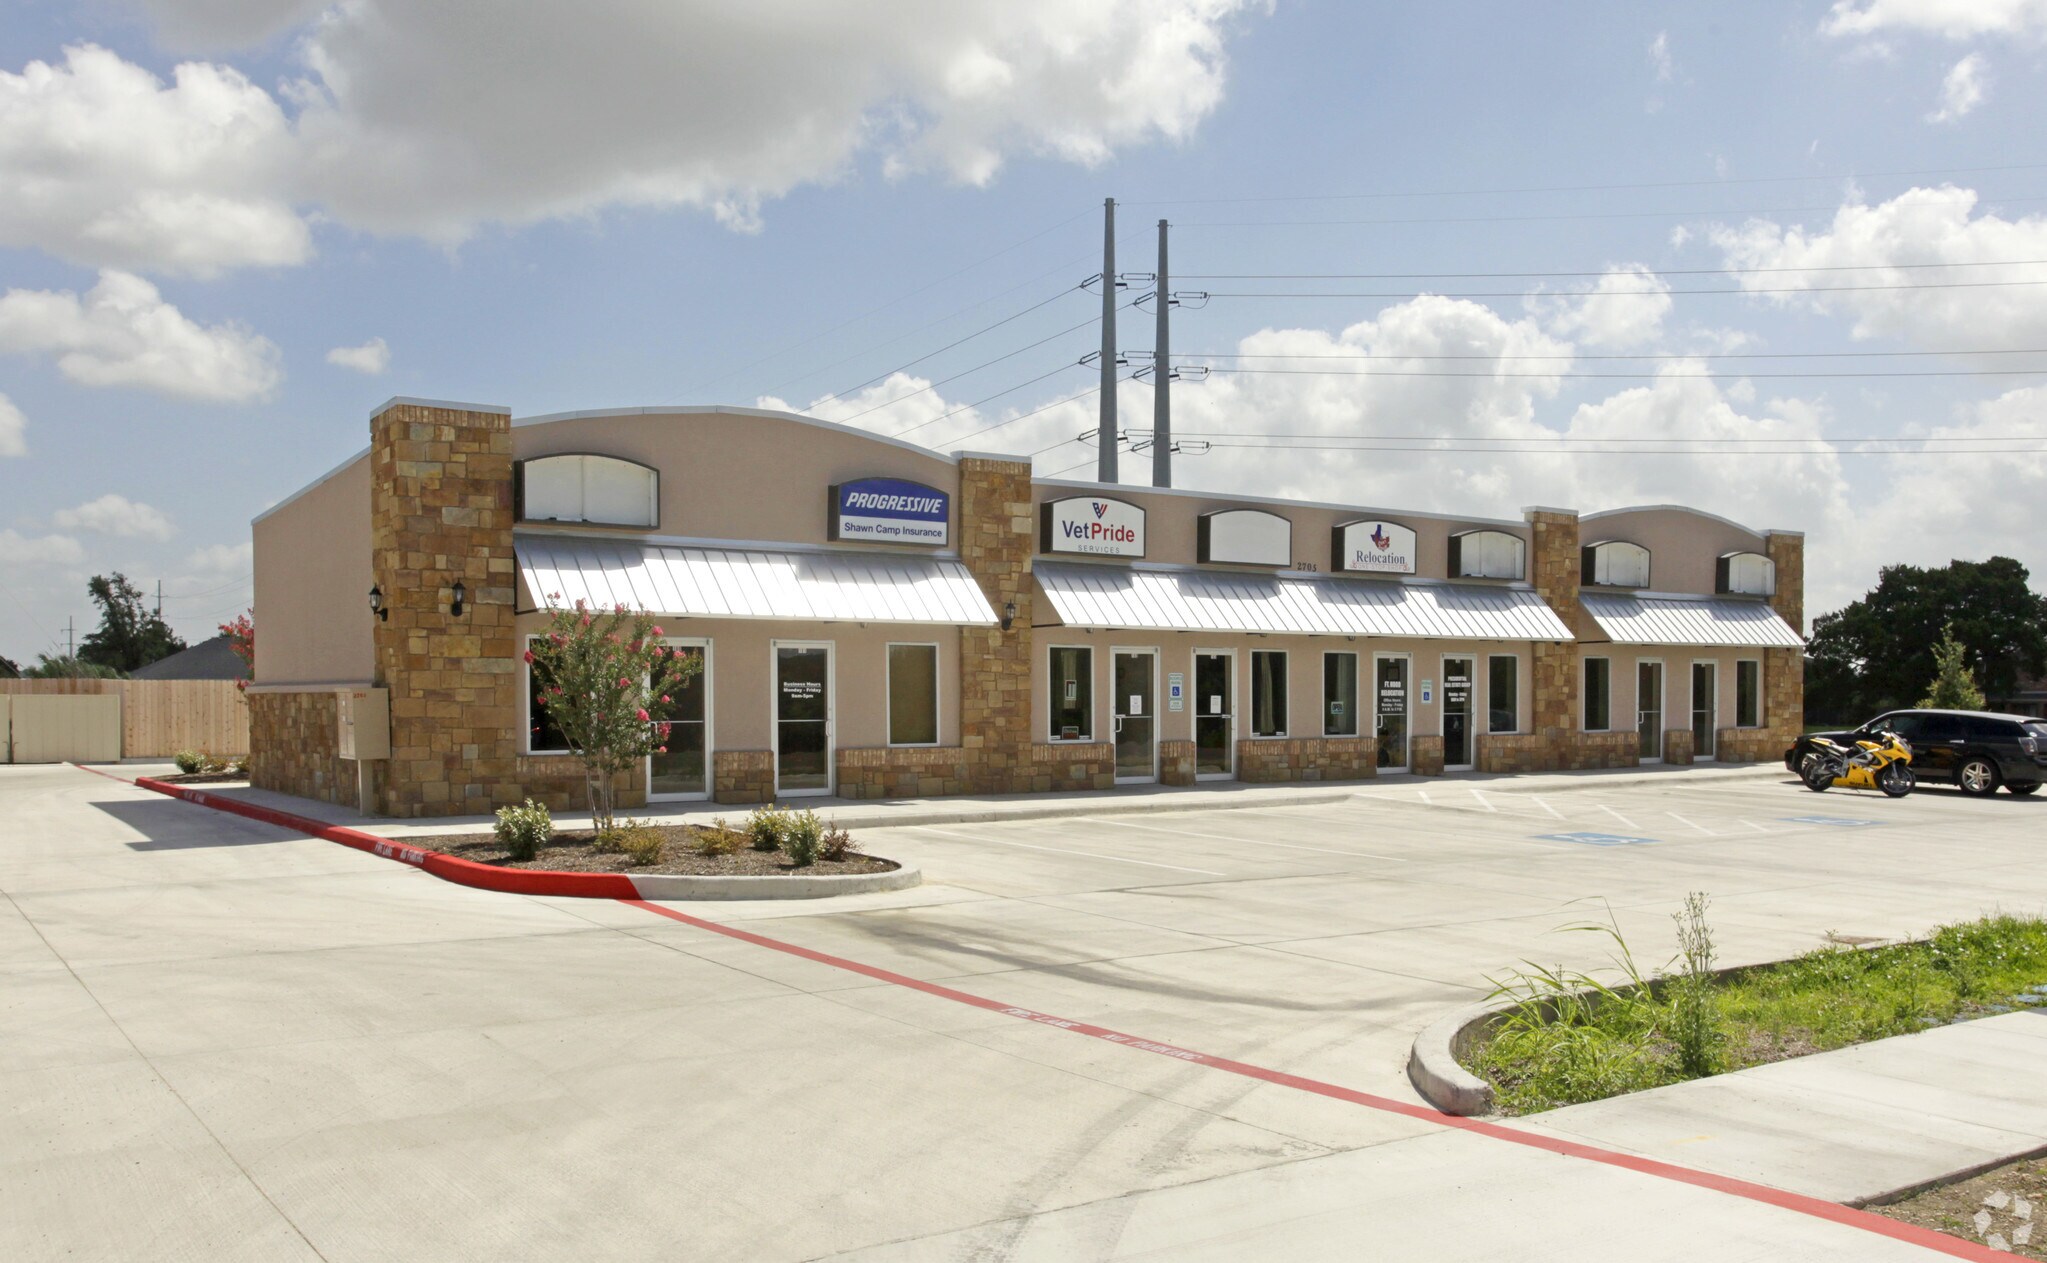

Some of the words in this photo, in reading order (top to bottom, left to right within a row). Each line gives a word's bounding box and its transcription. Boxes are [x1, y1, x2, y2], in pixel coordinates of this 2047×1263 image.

[845, 492, 943, 513] PROGRESSIVE
[844, 522, 874, 533] Shawn
[876, 524, 901, 536] Camp
[903, 526, 943, 537] Insurance
[1062, 520, 1135, 542] VetPride
[1078, 545, 1120, 554] SERVICES
[1356, 550, 1405, 564] Relocation
[1297, 562, 1317, 572] 2705
